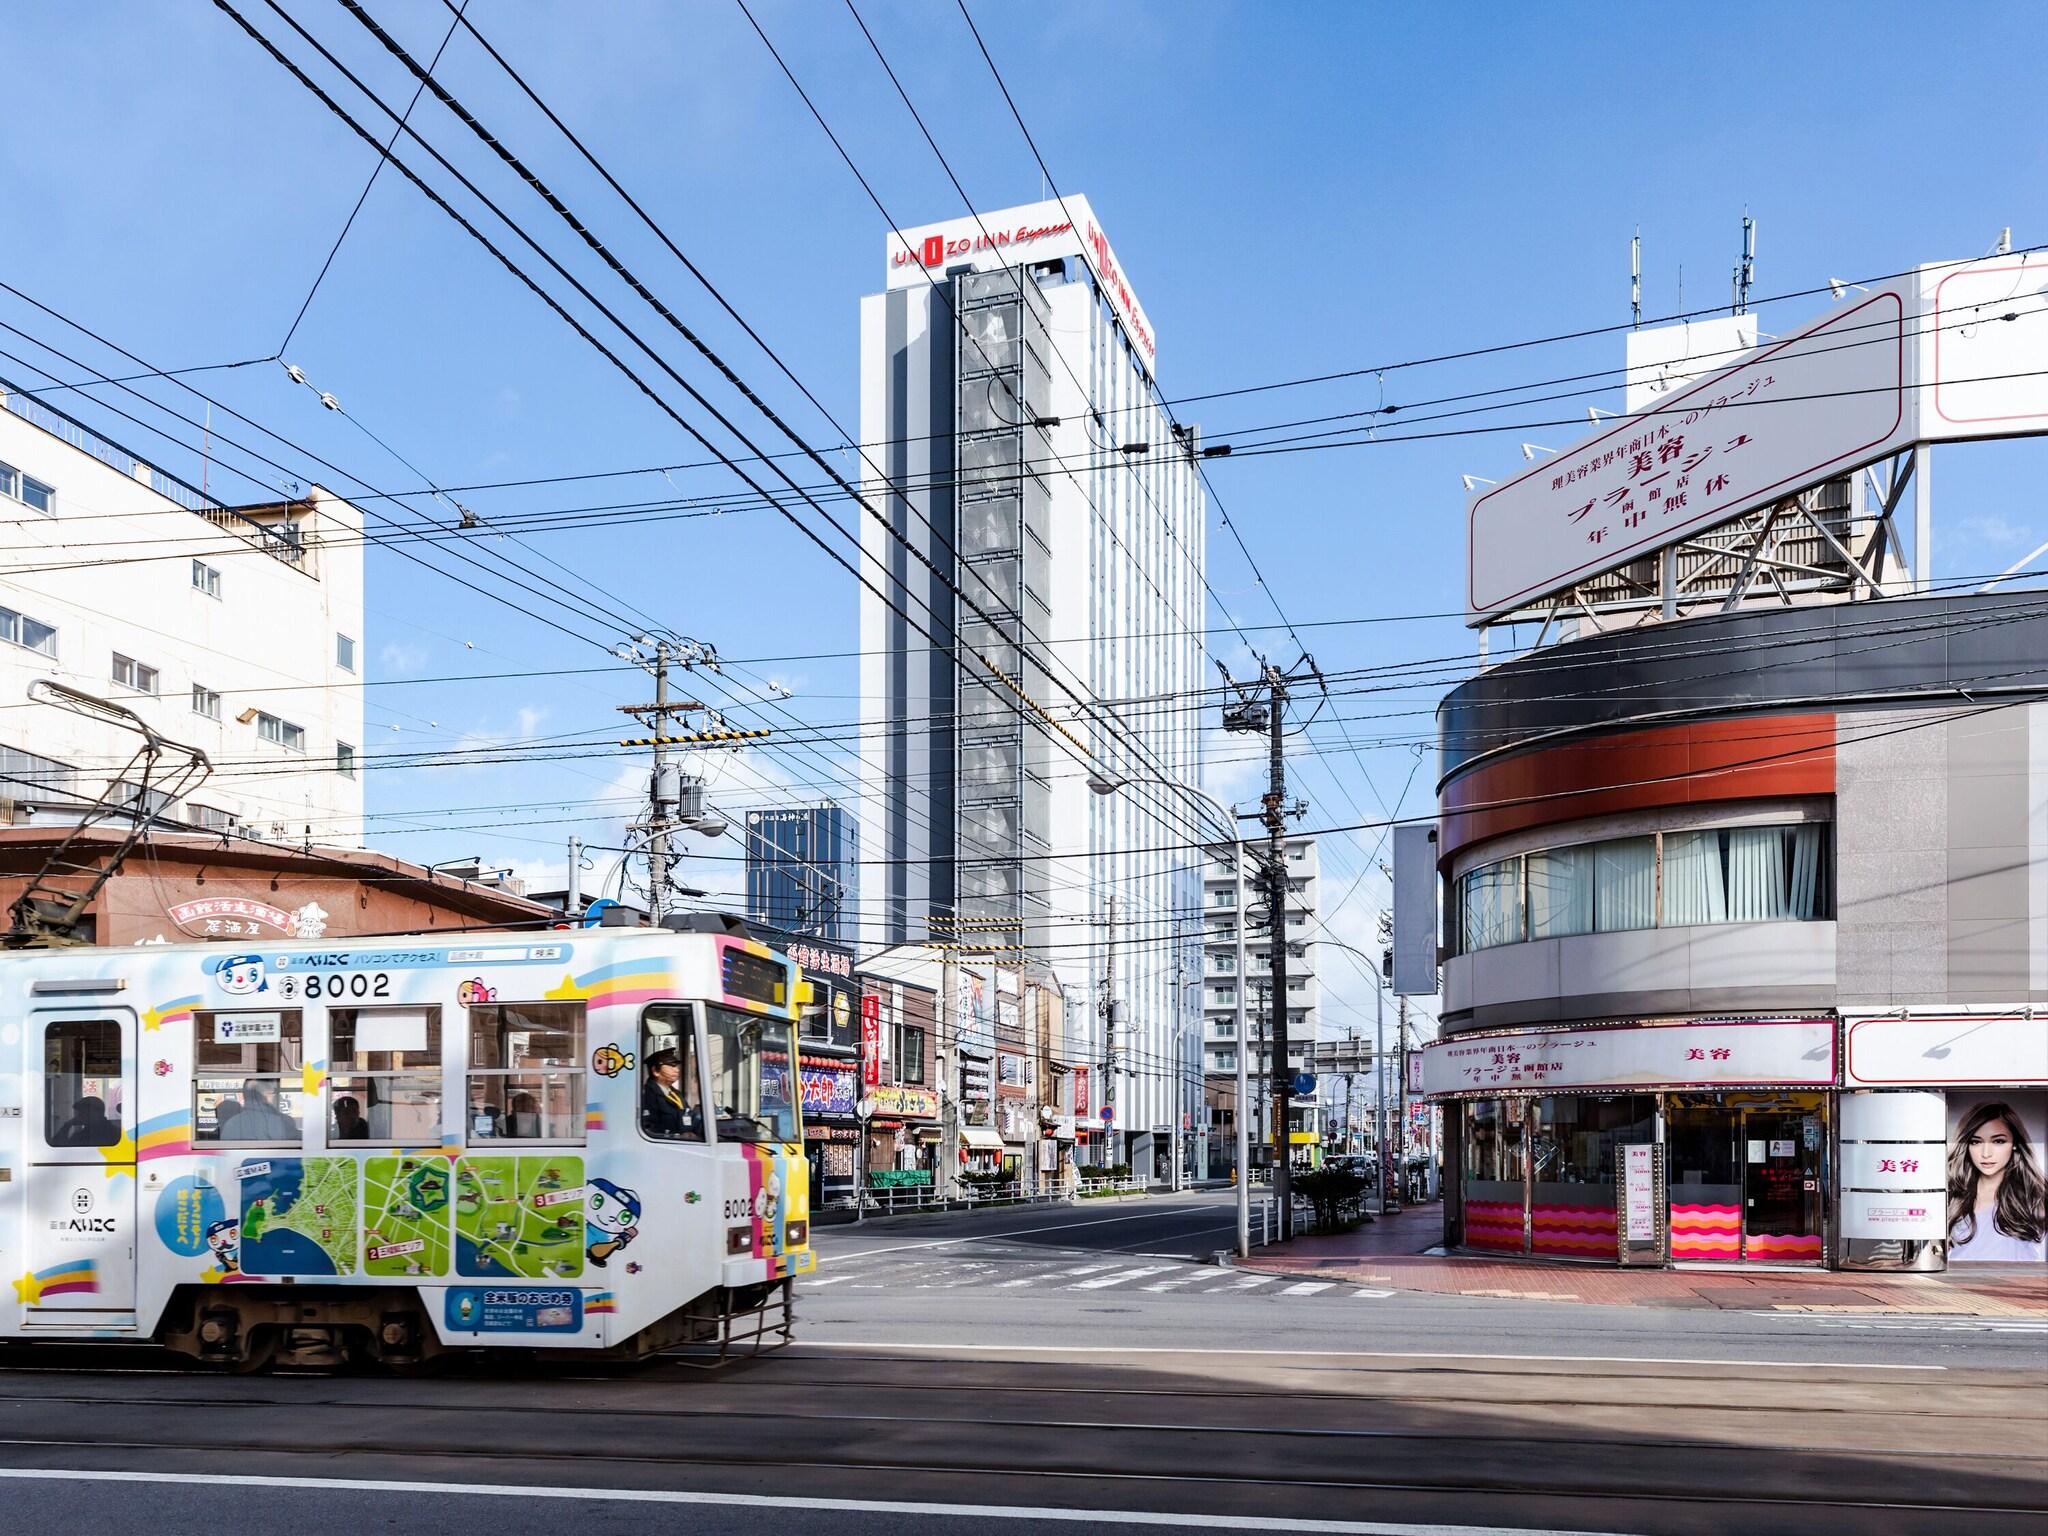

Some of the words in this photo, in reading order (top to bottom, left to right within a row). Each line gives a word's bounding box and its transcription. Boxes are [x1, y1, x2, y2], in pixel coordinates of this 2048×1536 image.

[895, 235, 971, 267] UNIZO
[976, 230, 1011, 248] INN
[1015, 221, 1072, 241] Express
[1628, 435, 1685, 481] 美容
[1567, 434, 1753, 526] プラージュ
[1622, 474, 1690, 514] 函館店
[1587, 474, 1730, 544] 年中無休
[304, 973, 390, 999] 8002
[1491, 1053, 1521, 1065] 美容
[1684, 1048, 1732, 1061] 美容
[1877, 1159, 1919, 1173] 美容
[724, 1198, 753, 1220] 8002
